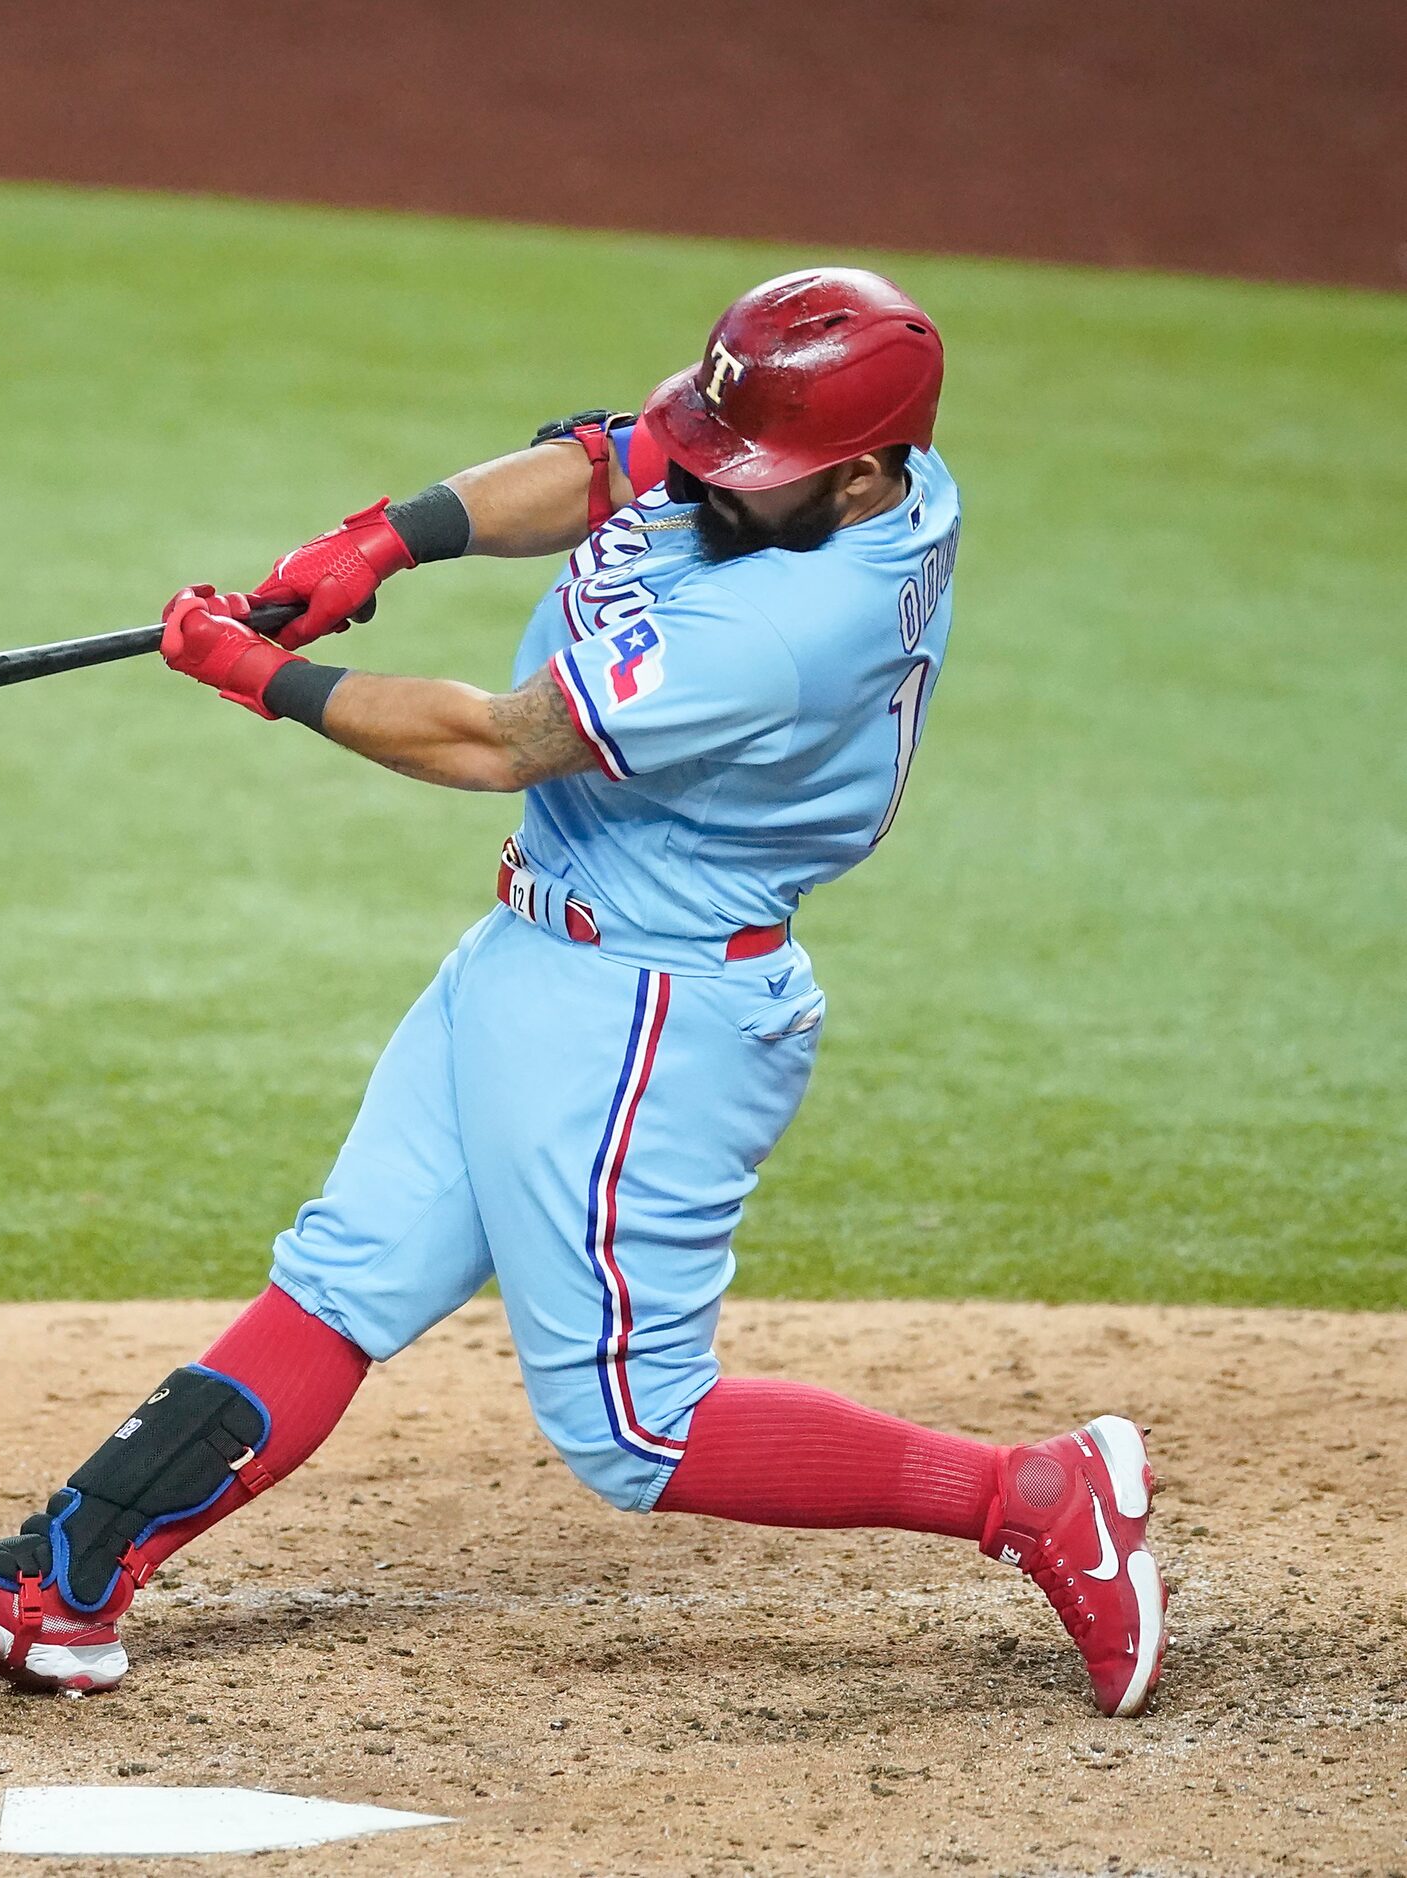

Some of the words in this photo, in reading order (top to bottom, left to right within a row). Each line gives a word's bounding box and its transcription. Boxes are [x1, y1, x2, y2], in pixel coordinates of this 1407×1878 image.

[705, 340, 746, 404] T
[898, 515, 961, 655] ODO
[513, 884, 524, 913] 12
